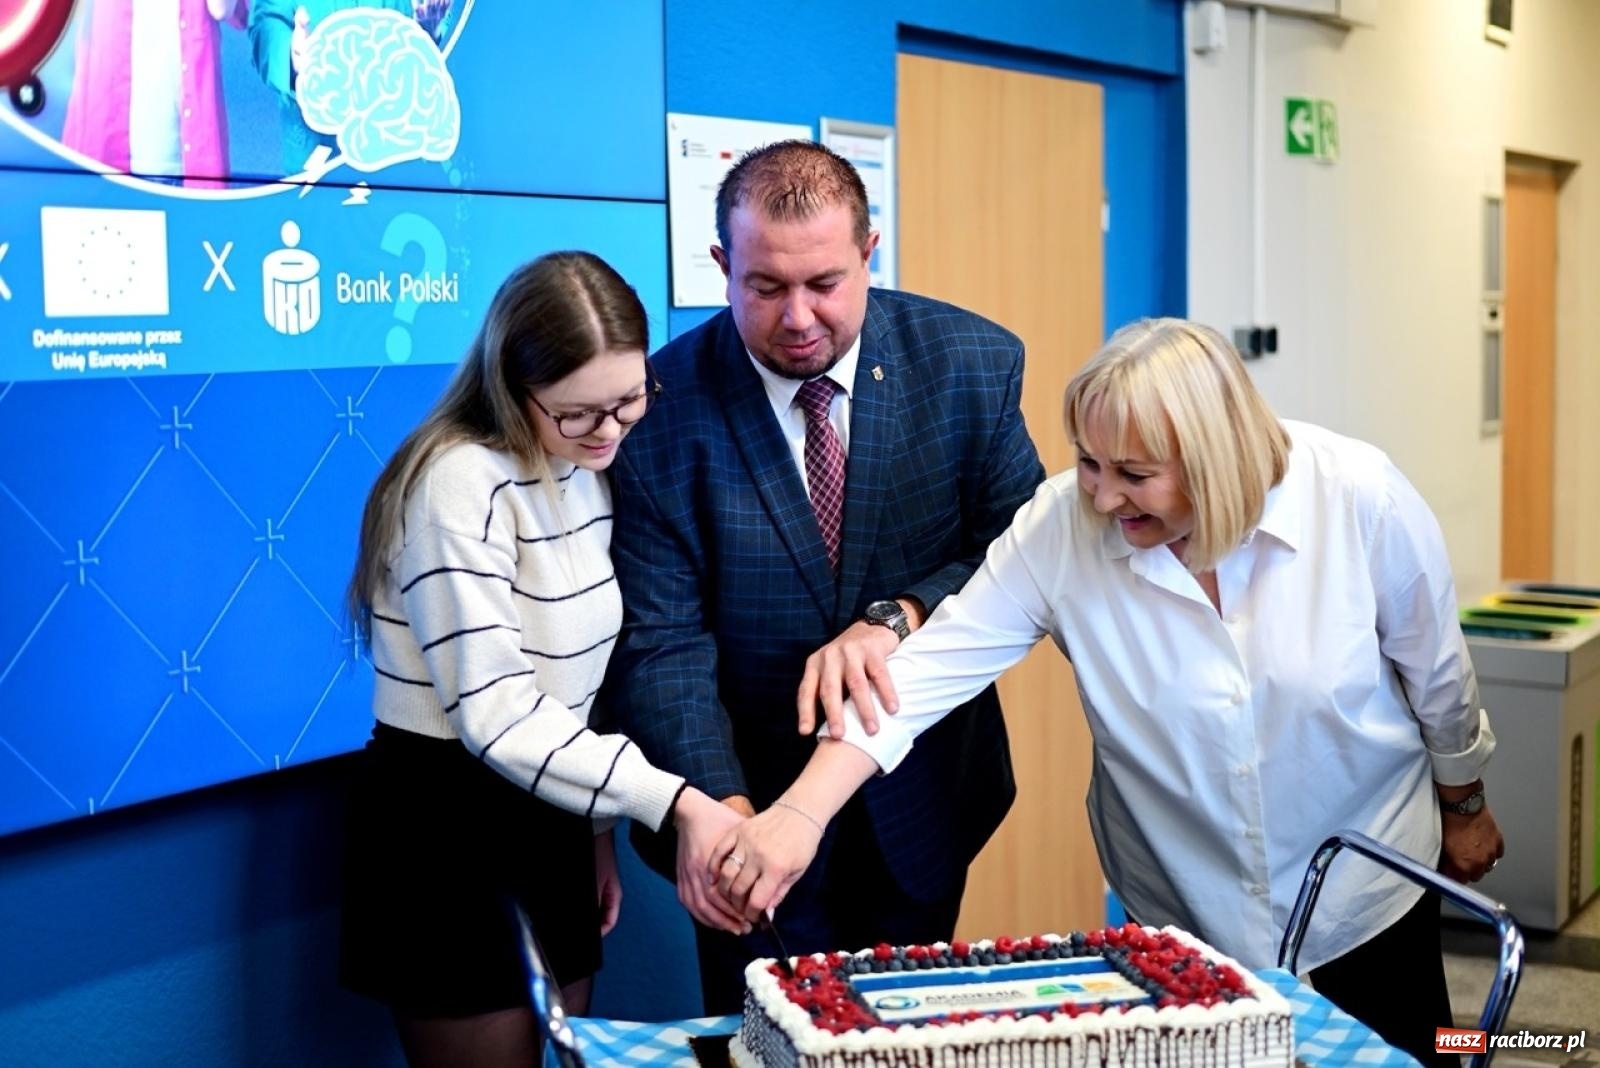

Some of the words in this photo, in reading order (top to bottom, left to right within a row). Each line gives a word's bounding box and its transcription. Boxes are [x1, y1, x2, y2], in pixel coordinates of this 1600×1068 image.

[336, 271, 393, 304] Bank
[399, 272, 459, 303] Polski
[32, 328, 143, 348] Dofinansowane
[145, 330, 183, 347] przez
[924, 989, 1023, 1003] AKADEMIA
